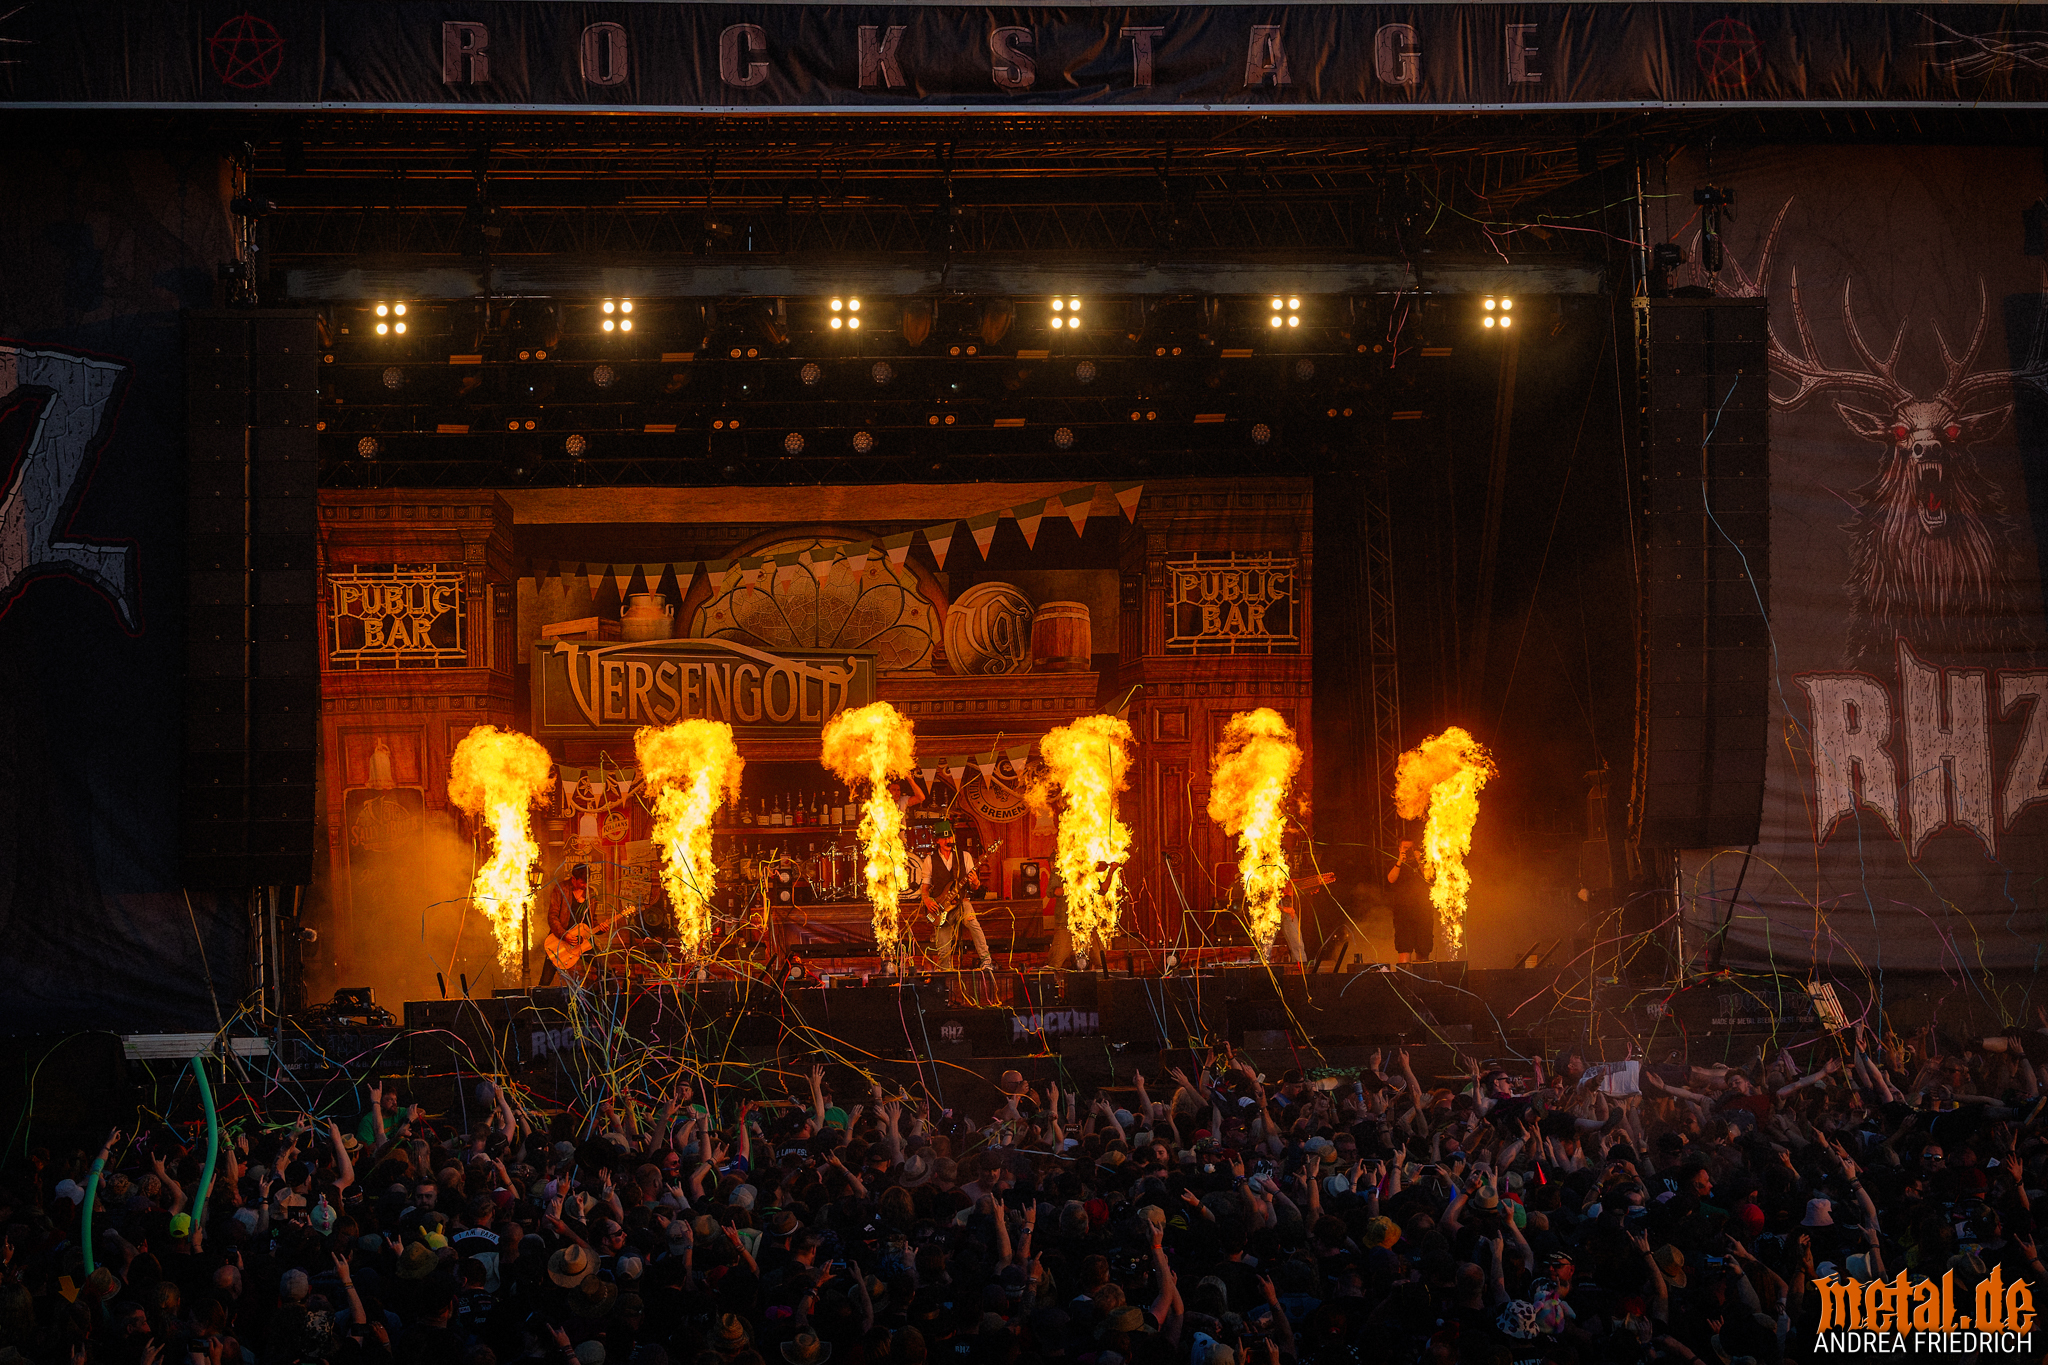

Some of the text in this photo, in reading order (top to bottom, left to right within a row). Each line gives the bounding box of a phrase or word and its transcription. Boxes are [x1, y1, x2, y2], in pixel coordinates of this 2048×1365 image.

[340, 586, 451, 615] PUBLIC
[1180, 572, 1285, 602] PUBLIC
[365, 617, 433, 647] BAR
[1202, 604, 1267, 634] BAR
[554, 637, 857, 730] VERSENGOLD
[980, 803, 1027, 819] BREMEN
